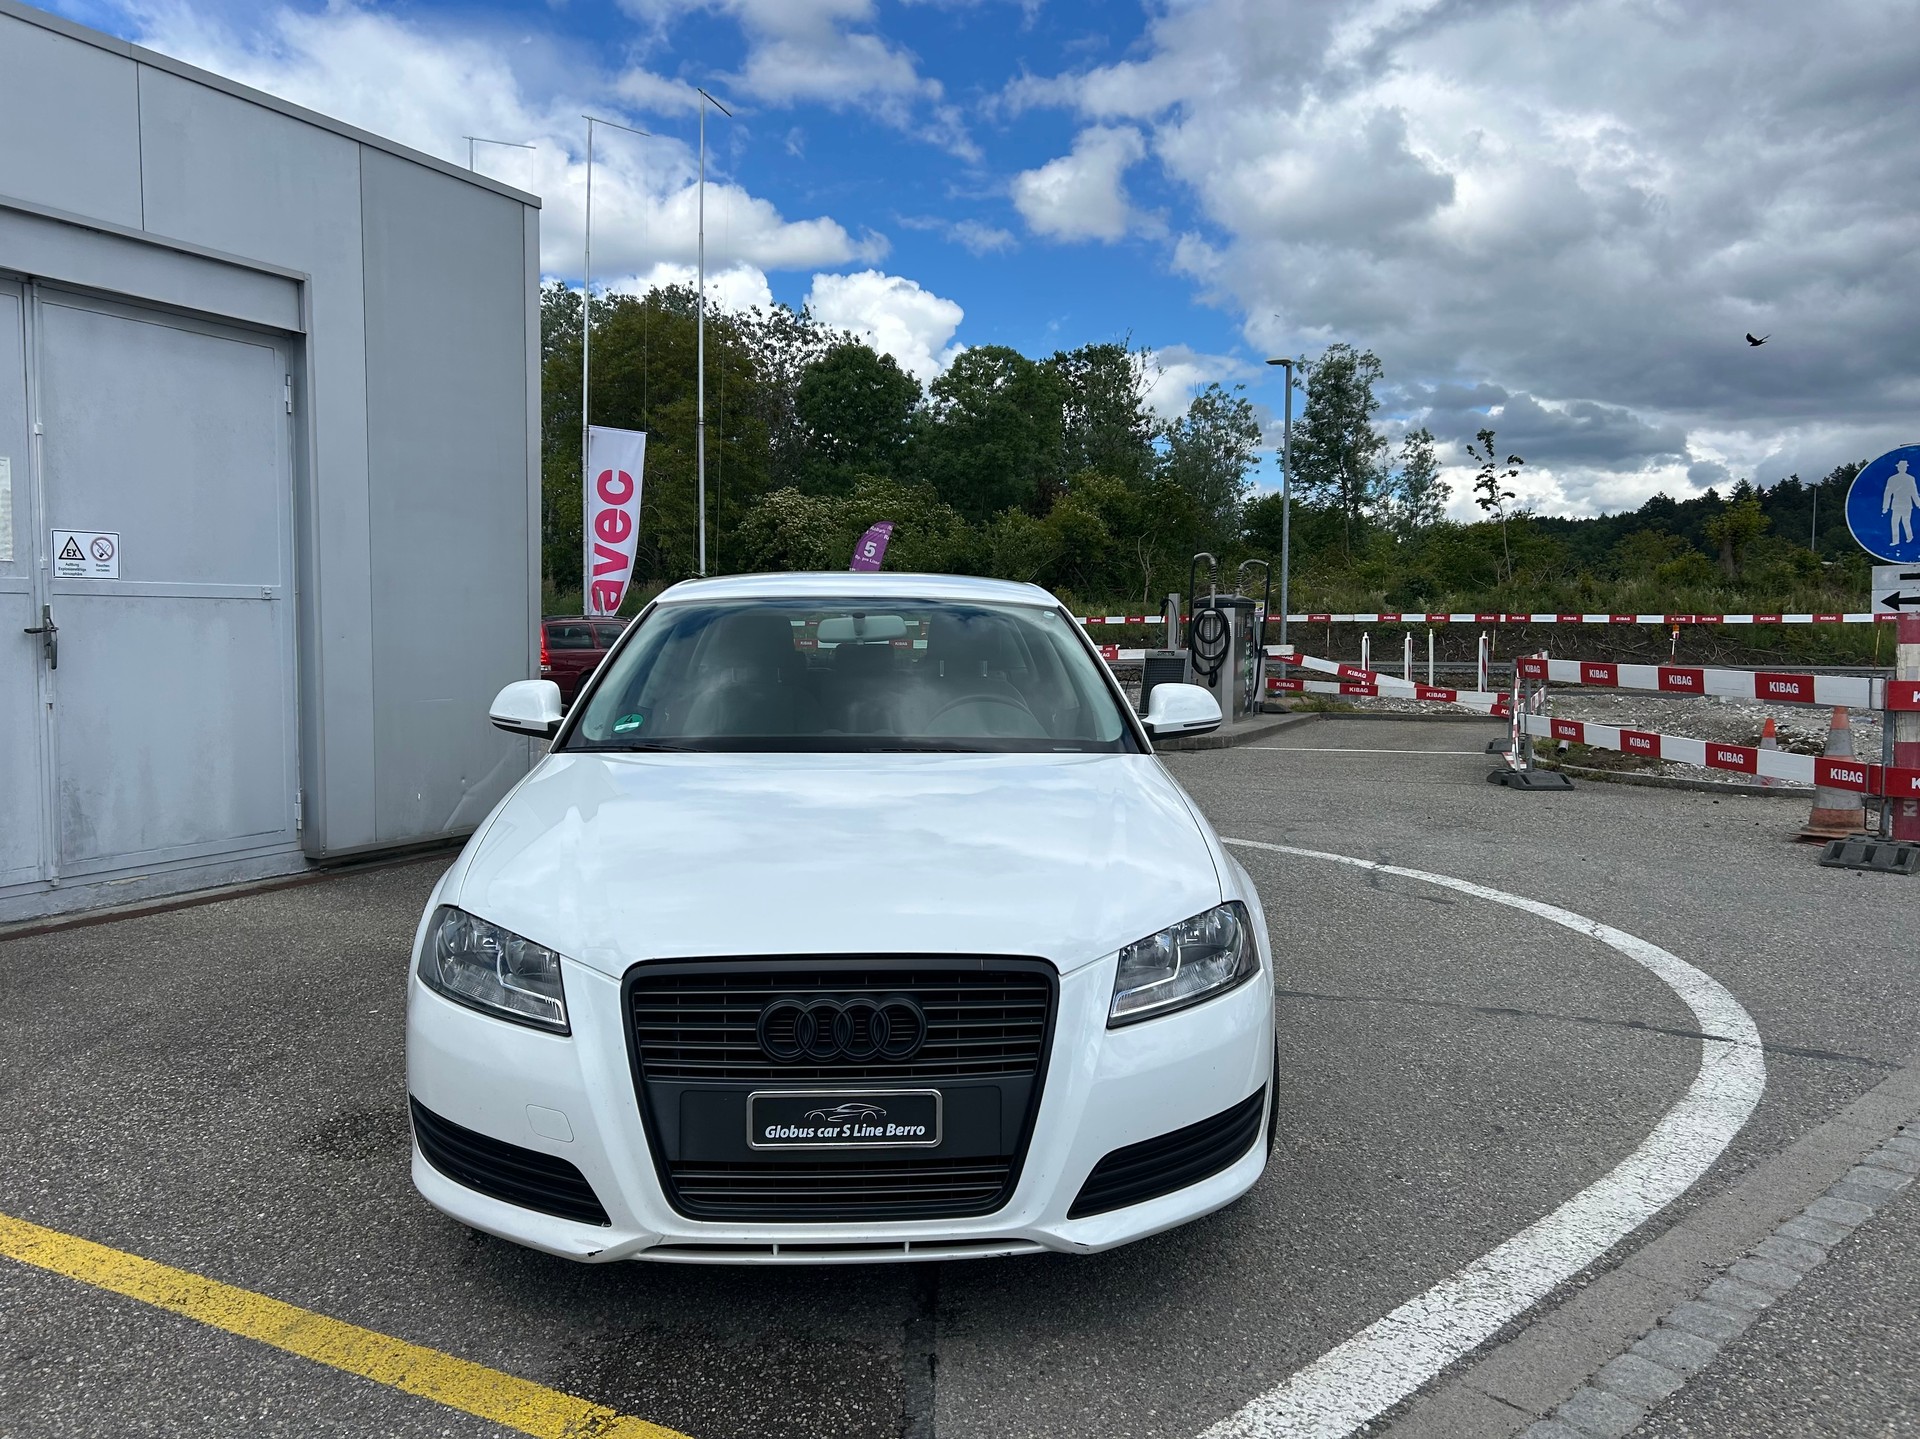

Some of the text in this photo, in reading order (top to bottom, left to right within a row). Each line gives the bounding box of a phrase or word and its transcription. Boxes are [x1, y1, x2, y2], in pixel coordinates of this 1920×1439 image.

[592, 469, 634, 612] avec
[67, 549, 77, 557] EX
[863, 541, 877, 557] 5
[1347, 670, 1367, 679] KIBAG
[1525, 664, 1541, 673] KIBAG
[1589, 669, 1608, 679] KIBAG
[1668, 674, 1693, 686] KIBAG
[1769, 681, 1800, 694] KIBAG
[1558, 726, 1576, 736] KIBAG
[1629, 736, 1650, 749] KIBAG
[1717, 750, 1744, 764] KIBAG
[1830, 768, 1864, 784] KIBAG
[765, 1123, 926, 1139] Globus car S Line Berro
